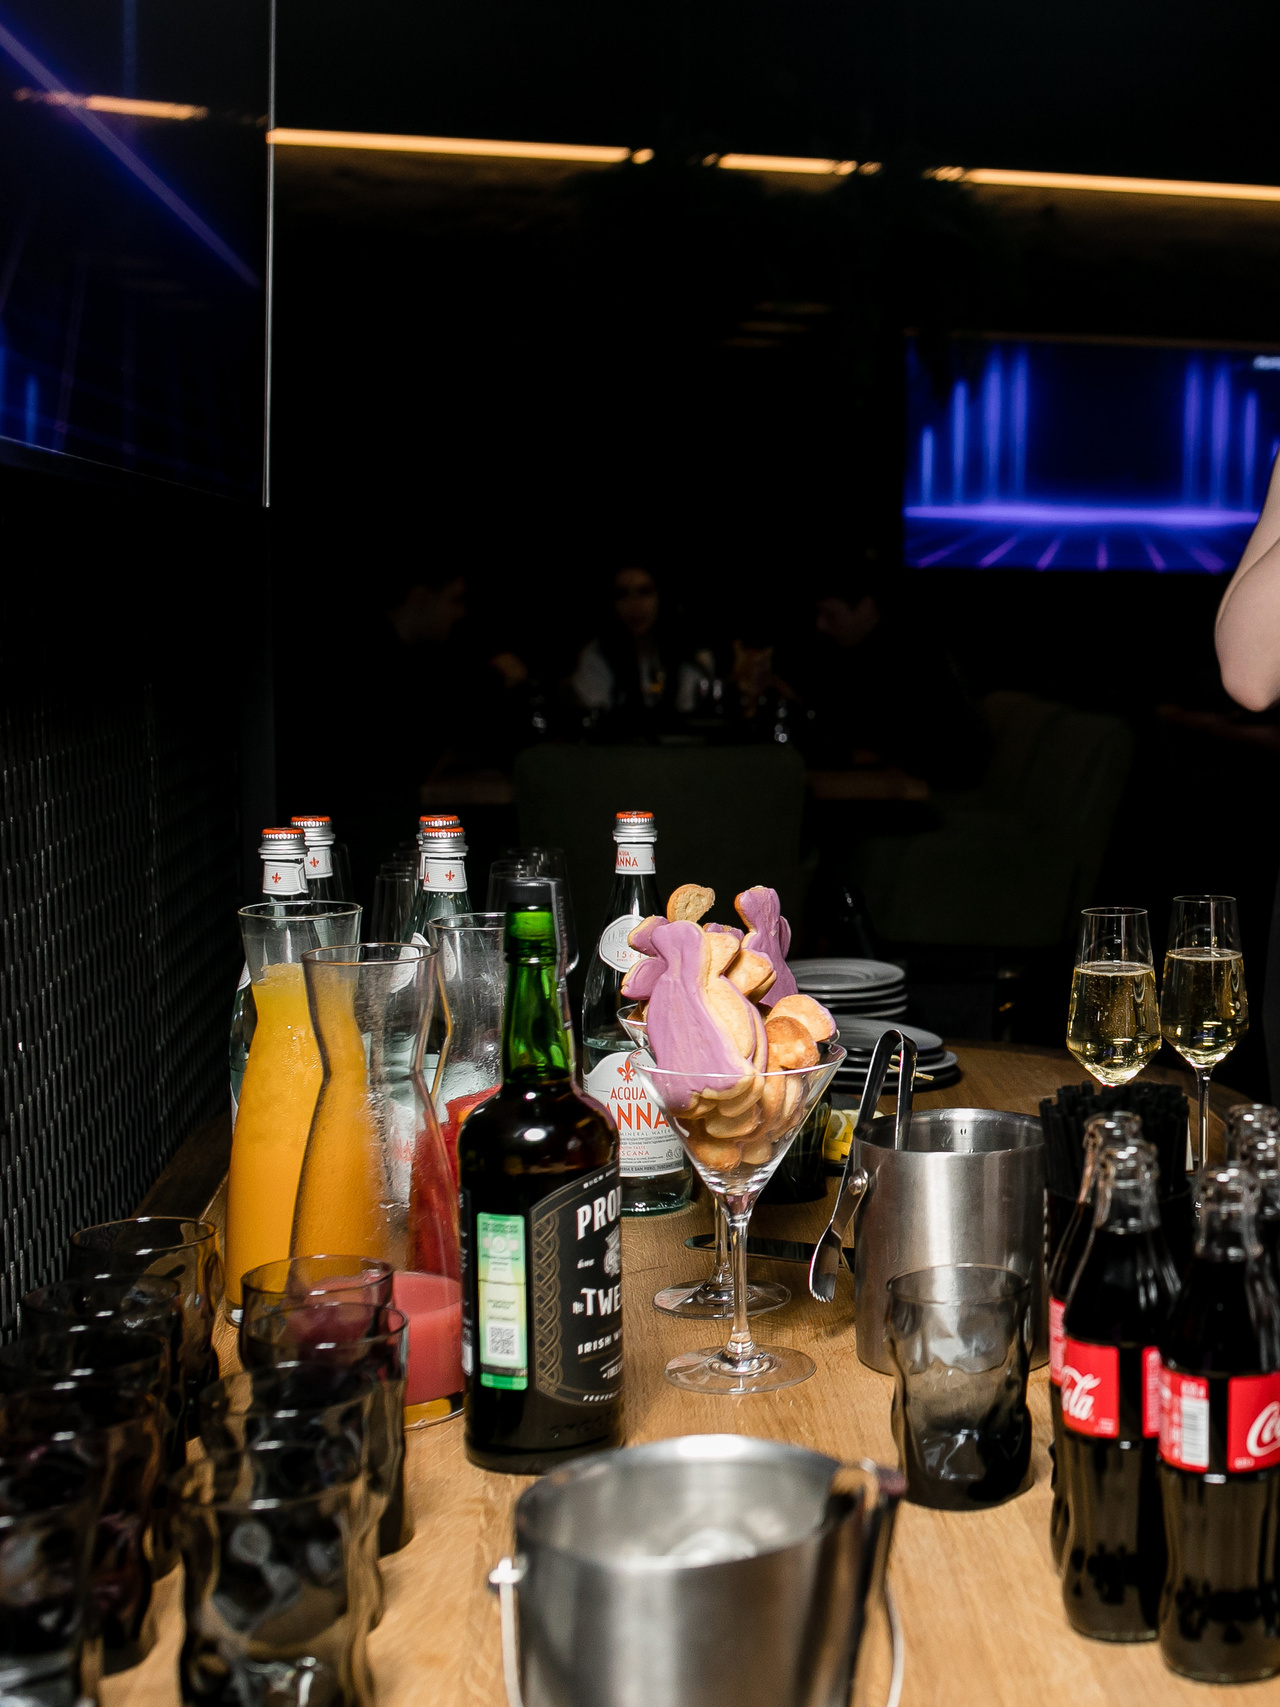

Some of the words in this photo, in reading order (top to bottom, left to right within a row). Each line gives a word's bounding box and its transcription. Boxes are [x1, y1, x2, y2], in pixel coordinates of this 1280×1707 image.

[610, 1087, 647, 1101] ACQUA
[605, 1102, 670, 1131] NNA
[577, 1334, 612, 1355] IRISH
